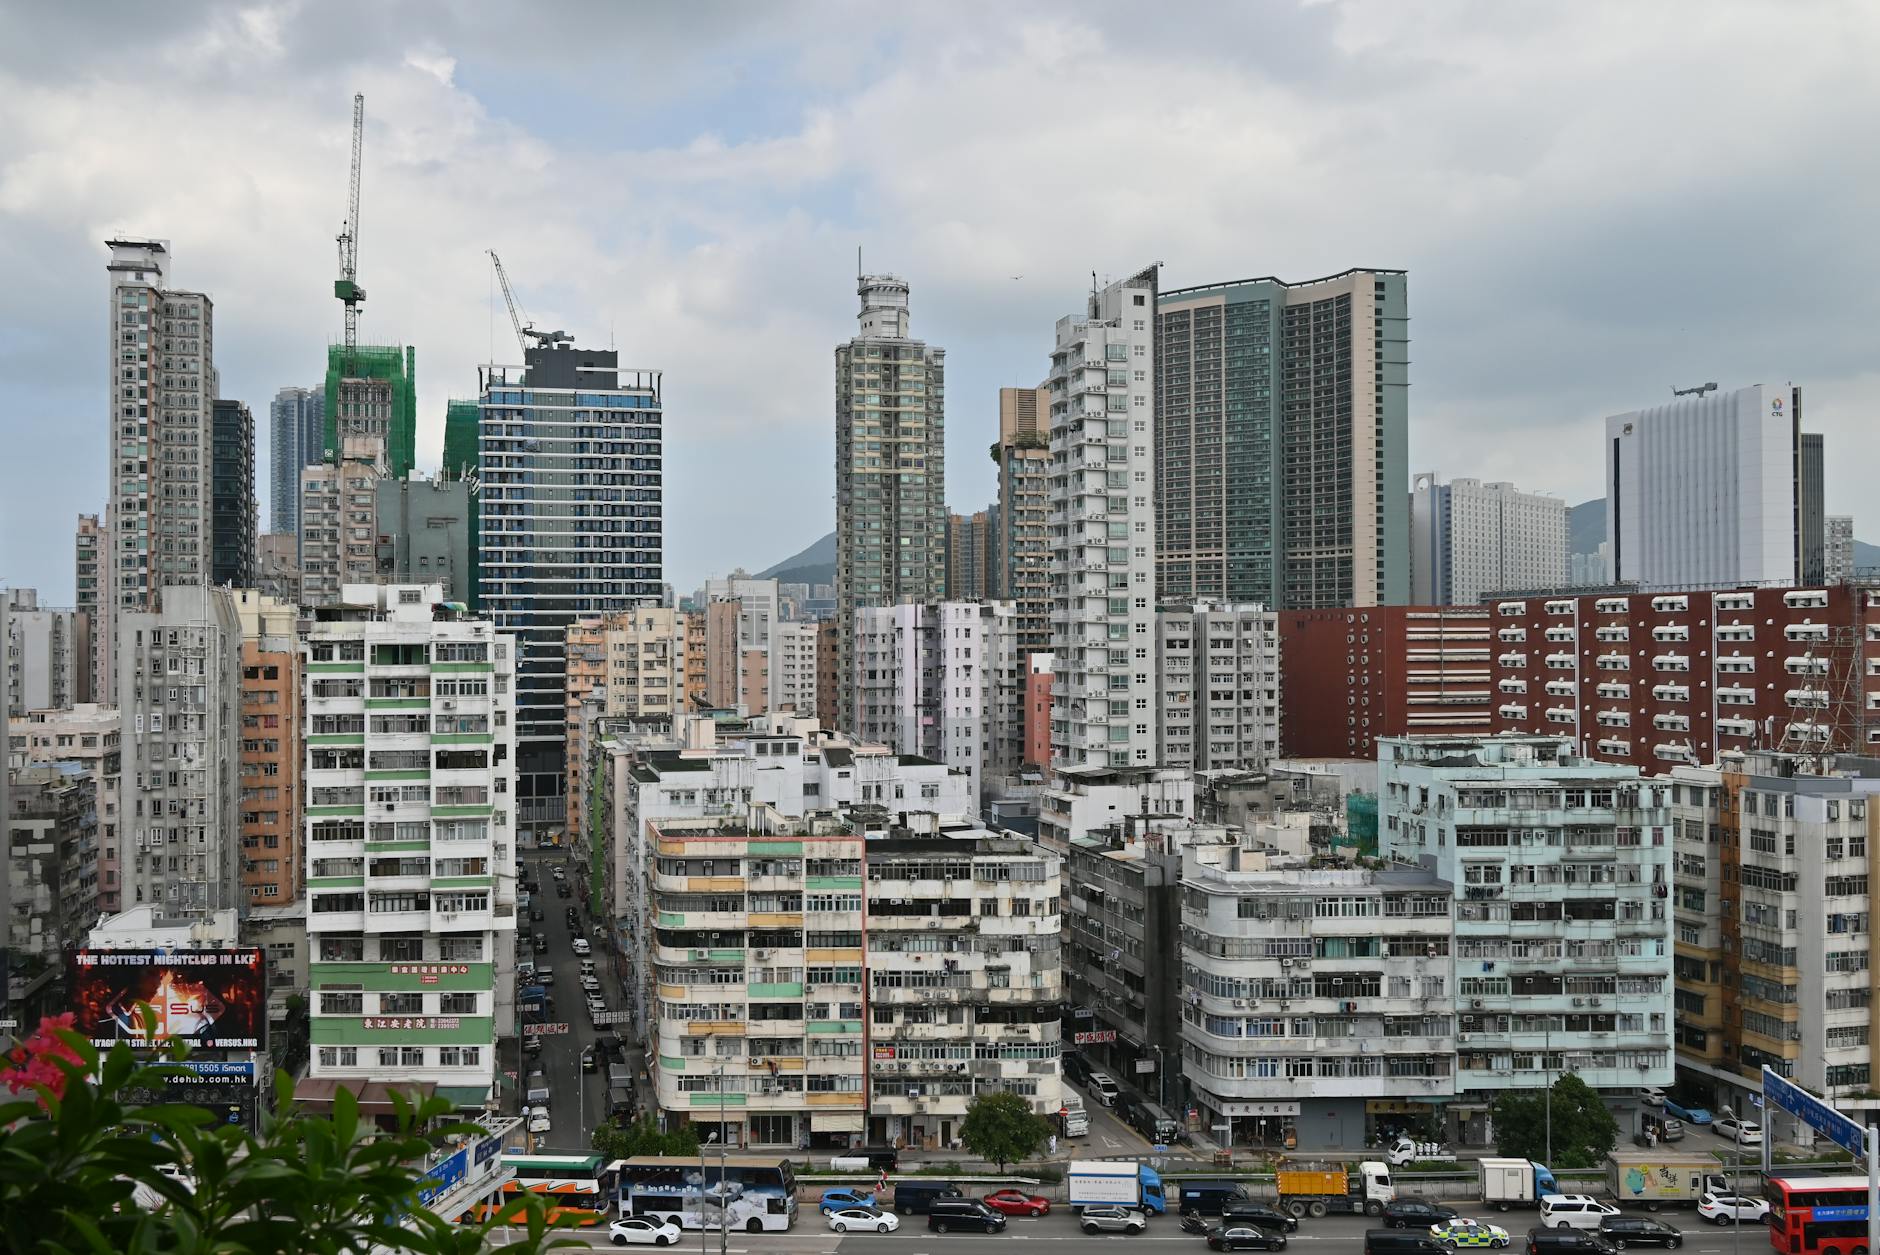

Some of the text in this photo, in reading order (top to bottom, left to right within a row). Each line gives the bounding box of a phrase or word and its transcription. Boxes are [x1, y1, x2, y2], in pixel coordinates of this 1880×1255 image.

[76, 954, 256, 965] THE HOTTEST NIGHTCLUB IN LKF
[94, 1038, 131, 1048] D'AGUR
[215, 1038, 257, 1048] VERSUS.HKG
[199, 1063, 219, 1072] 5505
[222, 1063, 246, 1072] iSmart
